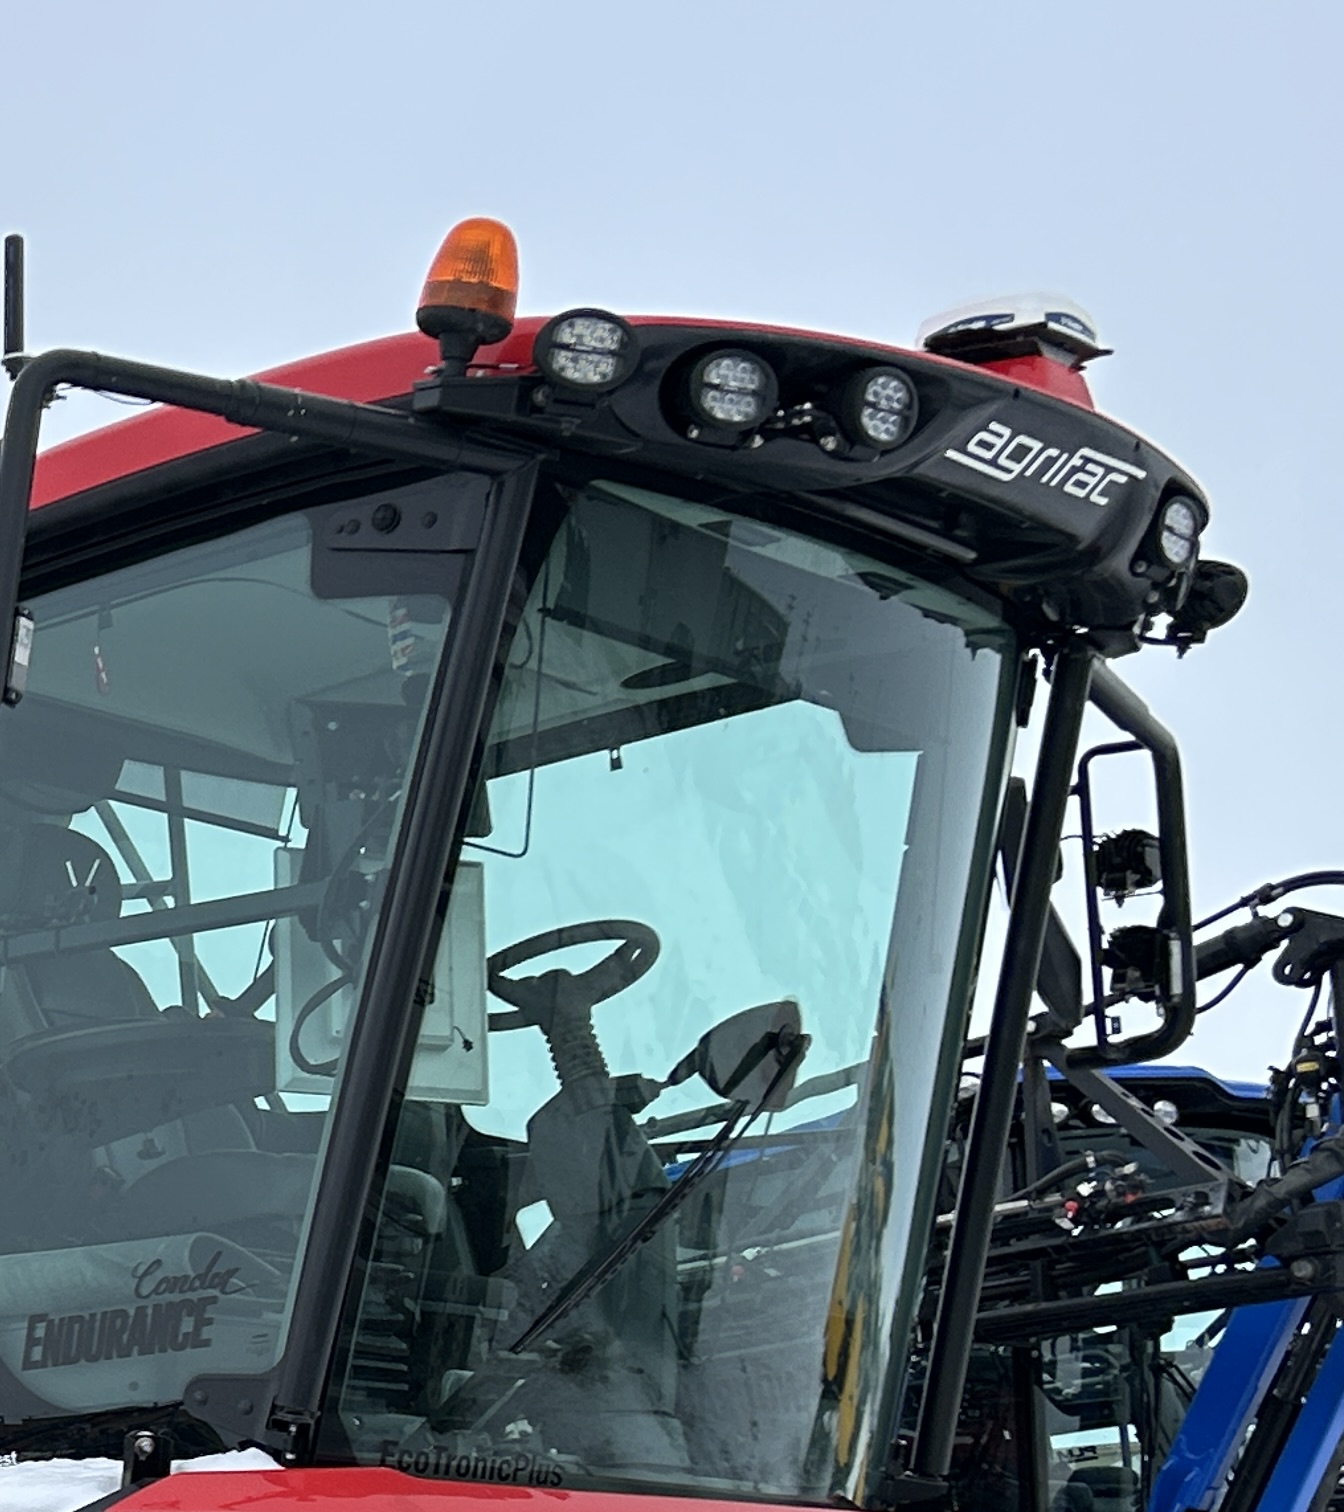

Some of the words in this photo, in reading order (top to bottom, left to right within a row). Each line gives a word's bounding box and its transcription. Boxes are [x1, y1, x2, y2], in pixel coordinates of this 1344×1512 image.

[944, 421, 1147, 506] agrifac
[21, 1296, 220, 1371] ENDURANCE
[379, 1440, 562, 1487] EcoTronicPlus
